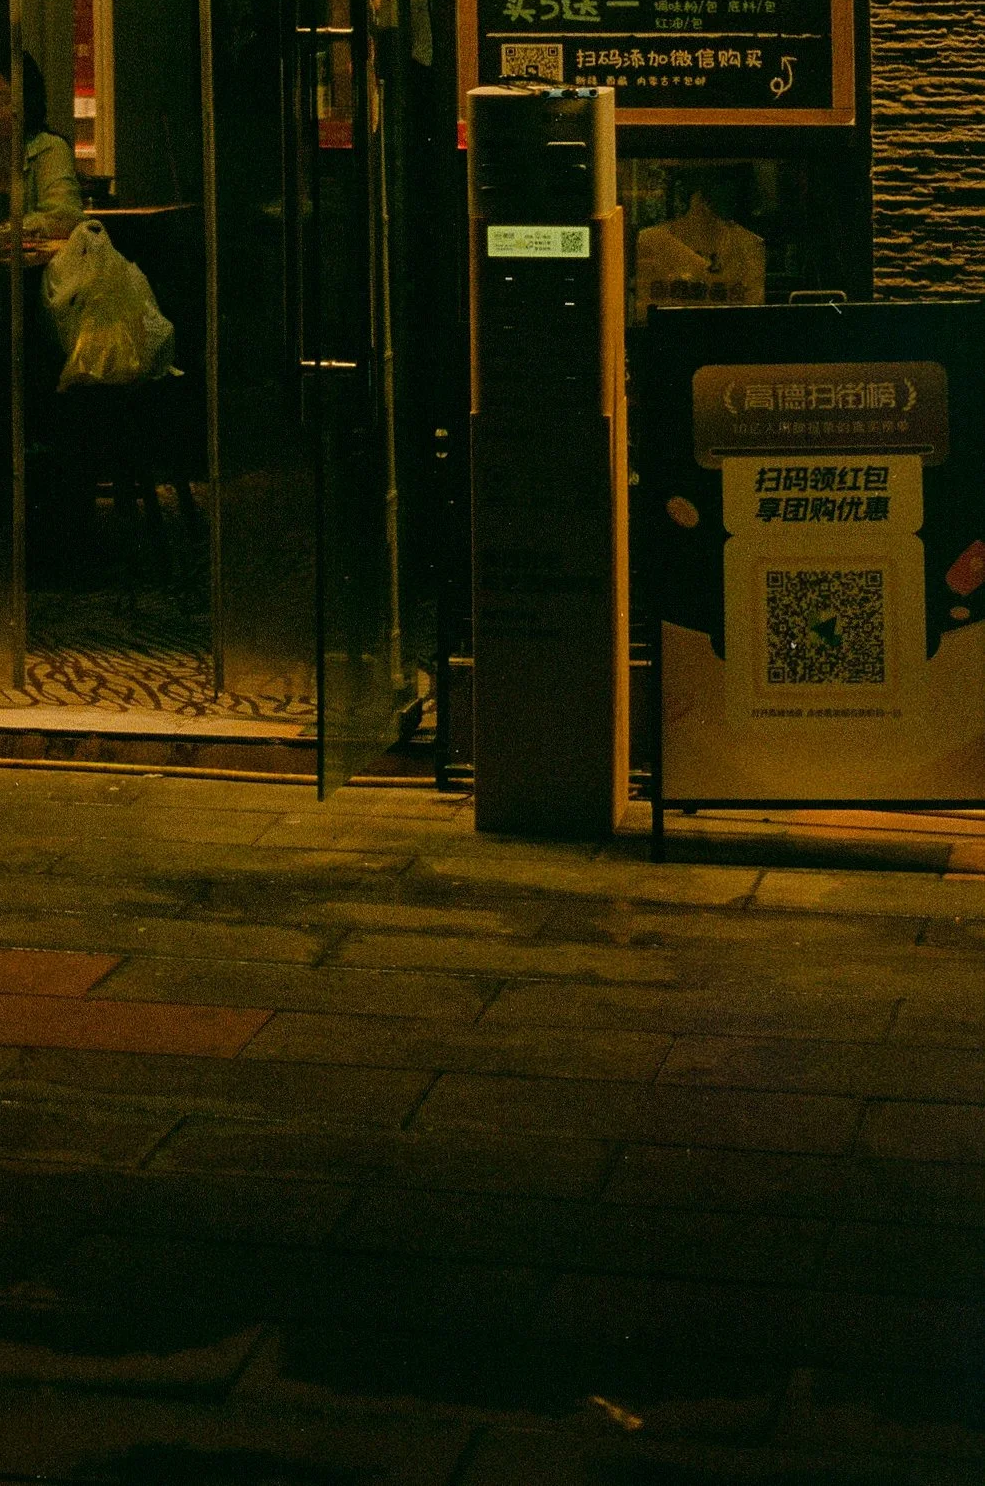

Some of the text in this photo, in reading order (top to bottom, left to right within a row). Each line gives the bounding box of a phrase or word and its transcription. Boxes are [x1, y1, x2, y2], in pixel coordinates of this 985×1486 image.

[576, 48, 763, 69] 扫码添加微信购买
[755, 465, 890, 492] 扫码领红包
[755, 496, 892, 523] 享团购优惠
